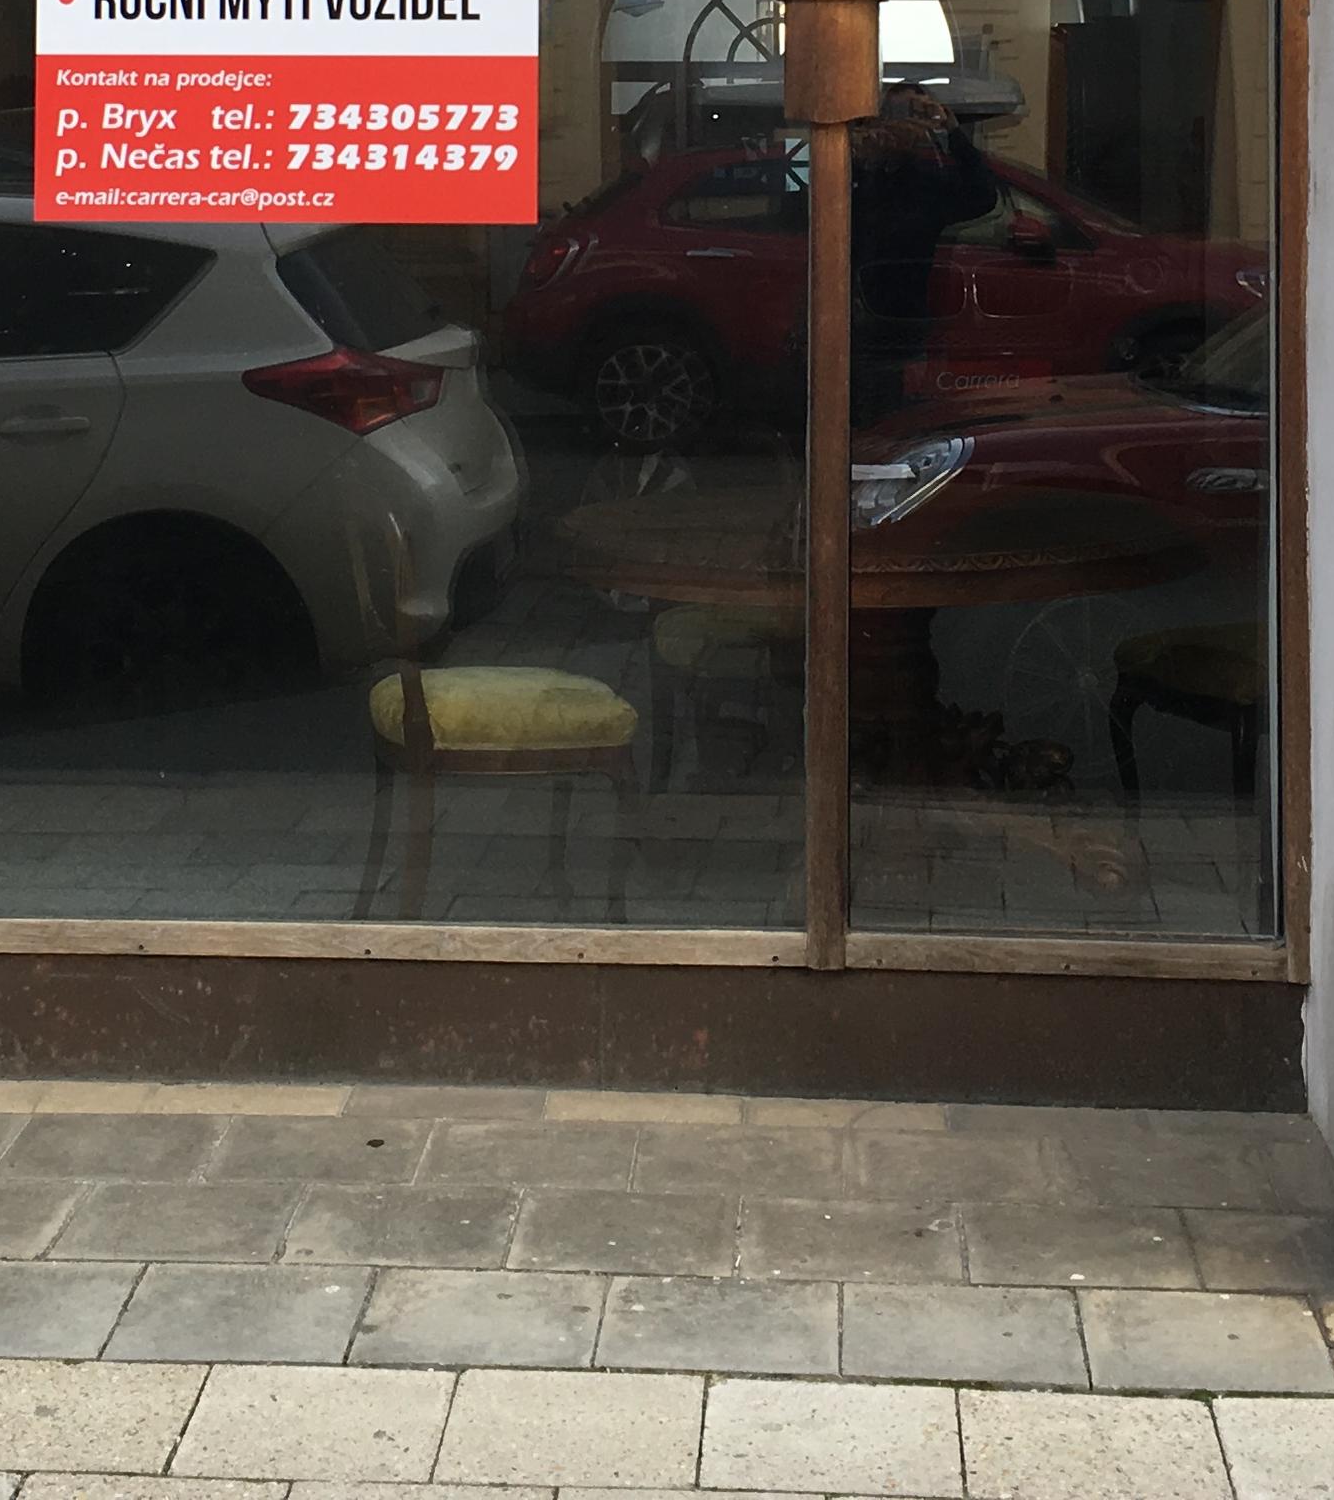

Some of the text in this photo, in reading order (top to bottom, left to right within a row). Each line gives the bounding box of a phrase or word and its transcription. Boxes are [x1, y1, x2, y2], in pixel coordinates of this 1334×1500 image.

[56, 68, 273, 91] Kontakt na prodejce:
[56, 102, 520, 137] p. Bryx tel.: 734305773
[55, 142, 519, 177] p. Nečas tel.: 734314379
[55, 187, 335, 211] e-mail:carrera-car@post.cz
